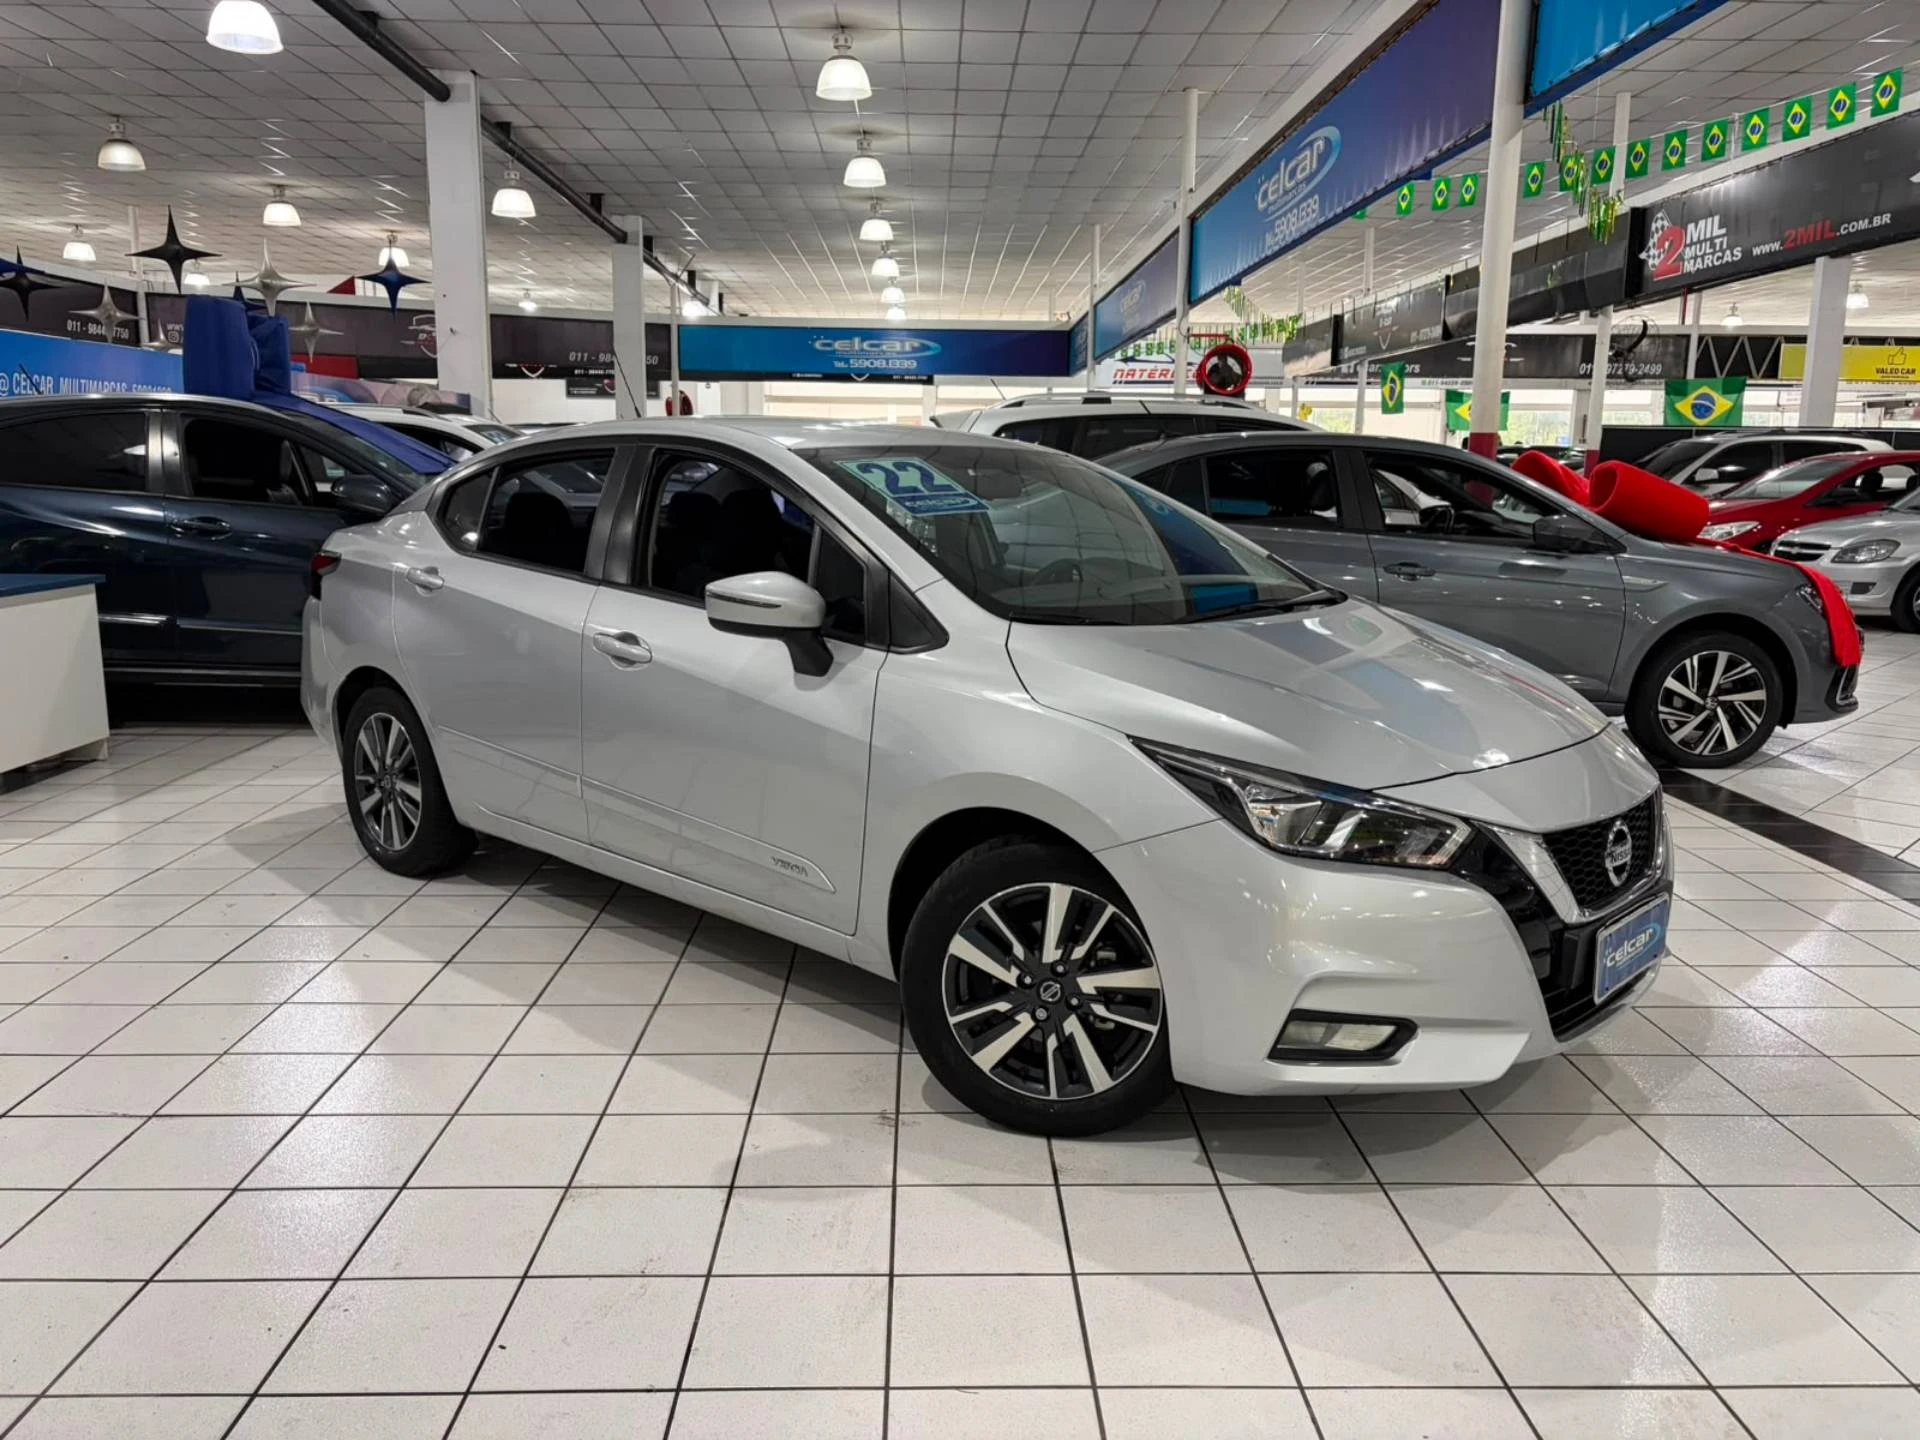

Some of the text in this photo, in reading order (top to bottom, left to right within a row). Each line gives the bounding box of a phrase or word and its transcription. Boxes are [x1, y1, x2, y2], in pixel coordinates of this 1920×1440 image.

[1257, 137, 1325, 212] celcar
[1653, 215, 1727, 281] 2 MIL
[1683, 247, 1742, 274] MARCAS
[1684, 236, 1728, 260] MULTI
[66, 319, 81, 332] 011
[813, 336, 922, 352] celcar
[856, 461, 958, 495] 22
[1606, 927, 1653, 967] celcar
